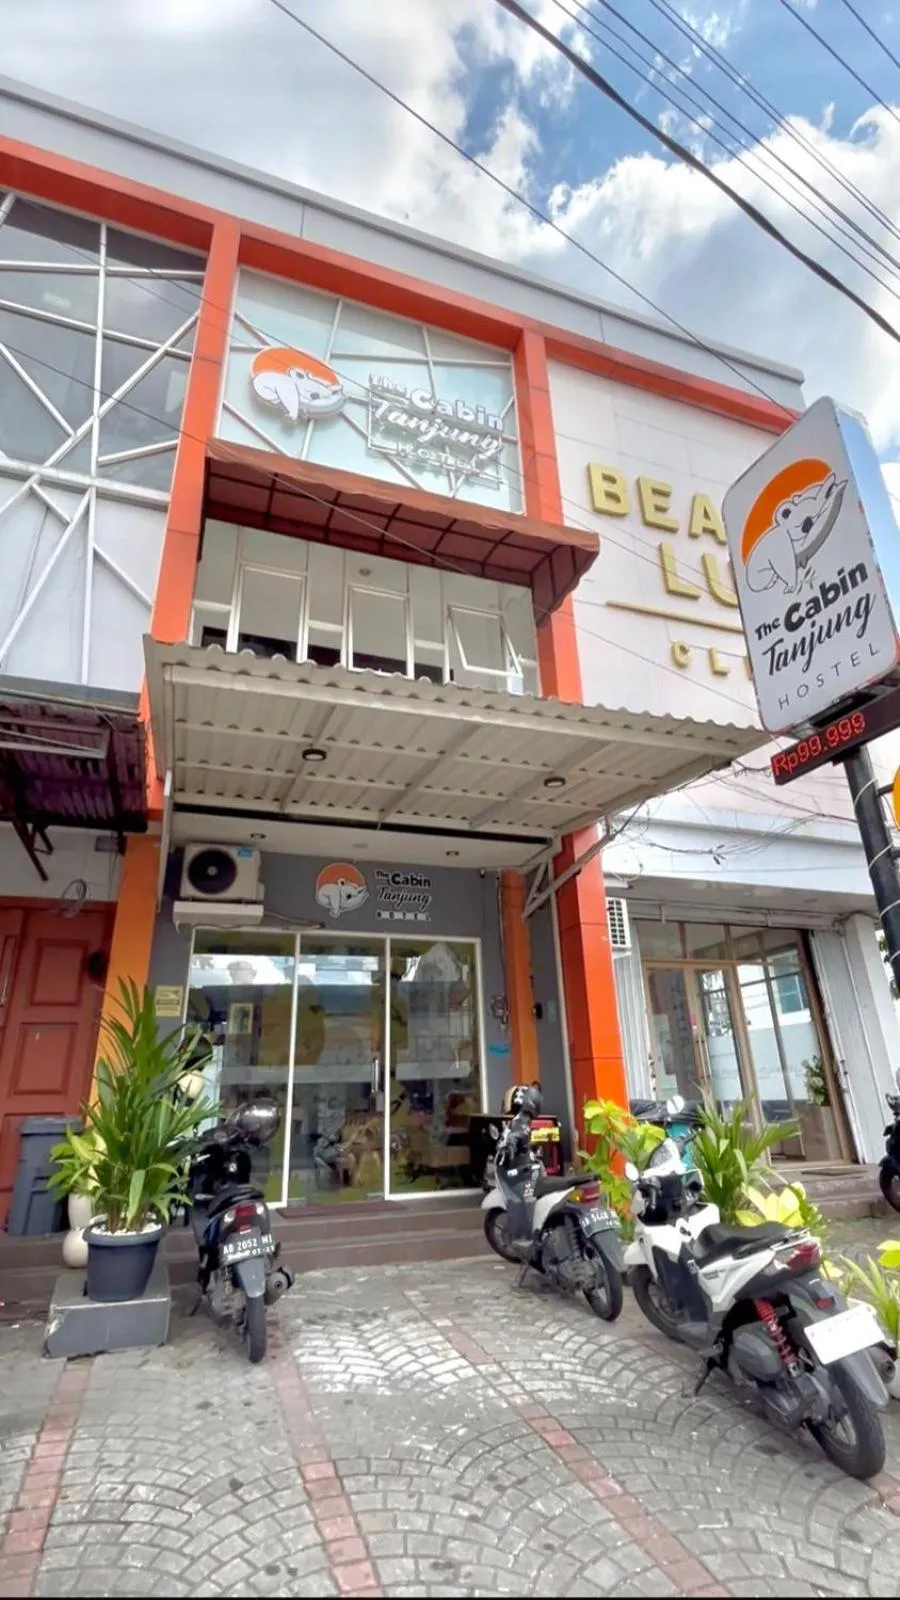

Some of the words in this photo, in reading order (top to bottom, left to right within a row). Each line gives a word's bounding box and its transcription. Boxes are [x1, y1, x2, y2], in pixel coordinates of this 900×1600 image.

[371, 397, 503, 460] Tanjung
[410, 387, 504, 431] Cabin
[586, 461, 728, 545] BEA
[754, 616, 782, 641] The
[783, 561, 869, 633] Cabin
[761, 593, 877, 676] Tanjung
[777, 643, 881, 711] HOSTEL
[772, 711, 867, 776] Rp99.999
[377, 886, 432, 910] Tanjung
[391, 872, 431, 888] Cabin
